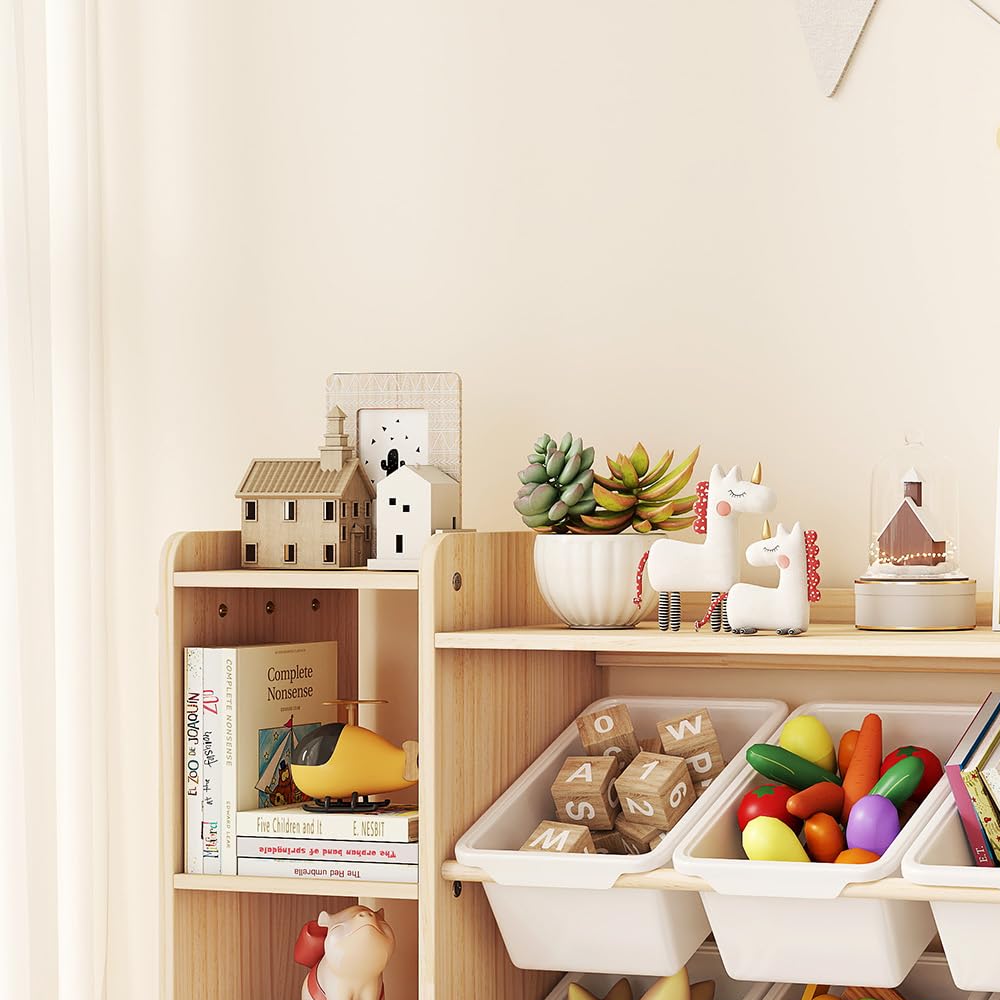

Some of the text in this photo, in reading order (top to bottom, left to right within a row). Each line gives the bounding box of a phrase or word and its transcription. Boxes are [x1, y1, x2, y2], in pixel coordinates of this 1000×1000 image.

[267, 665, 313, 683] Complete
[267, 686, 313, 701] Nonsense
[187, 692, 200, 744] JOAQUÍN
[203, 731, 218, 767] fashion
[566, 762, 592, 783] A
[639, 760, 660, 780] 1
[187, 787, 197, 796] EL
[203, 778, 211, 792] the
[257, 816, 323, 835] Five Children and It
[353, 821, 385, 837] E. NESBIT
[380, 850, 397, 858] The
[294, 868, 361, 878] The Red umbrella
